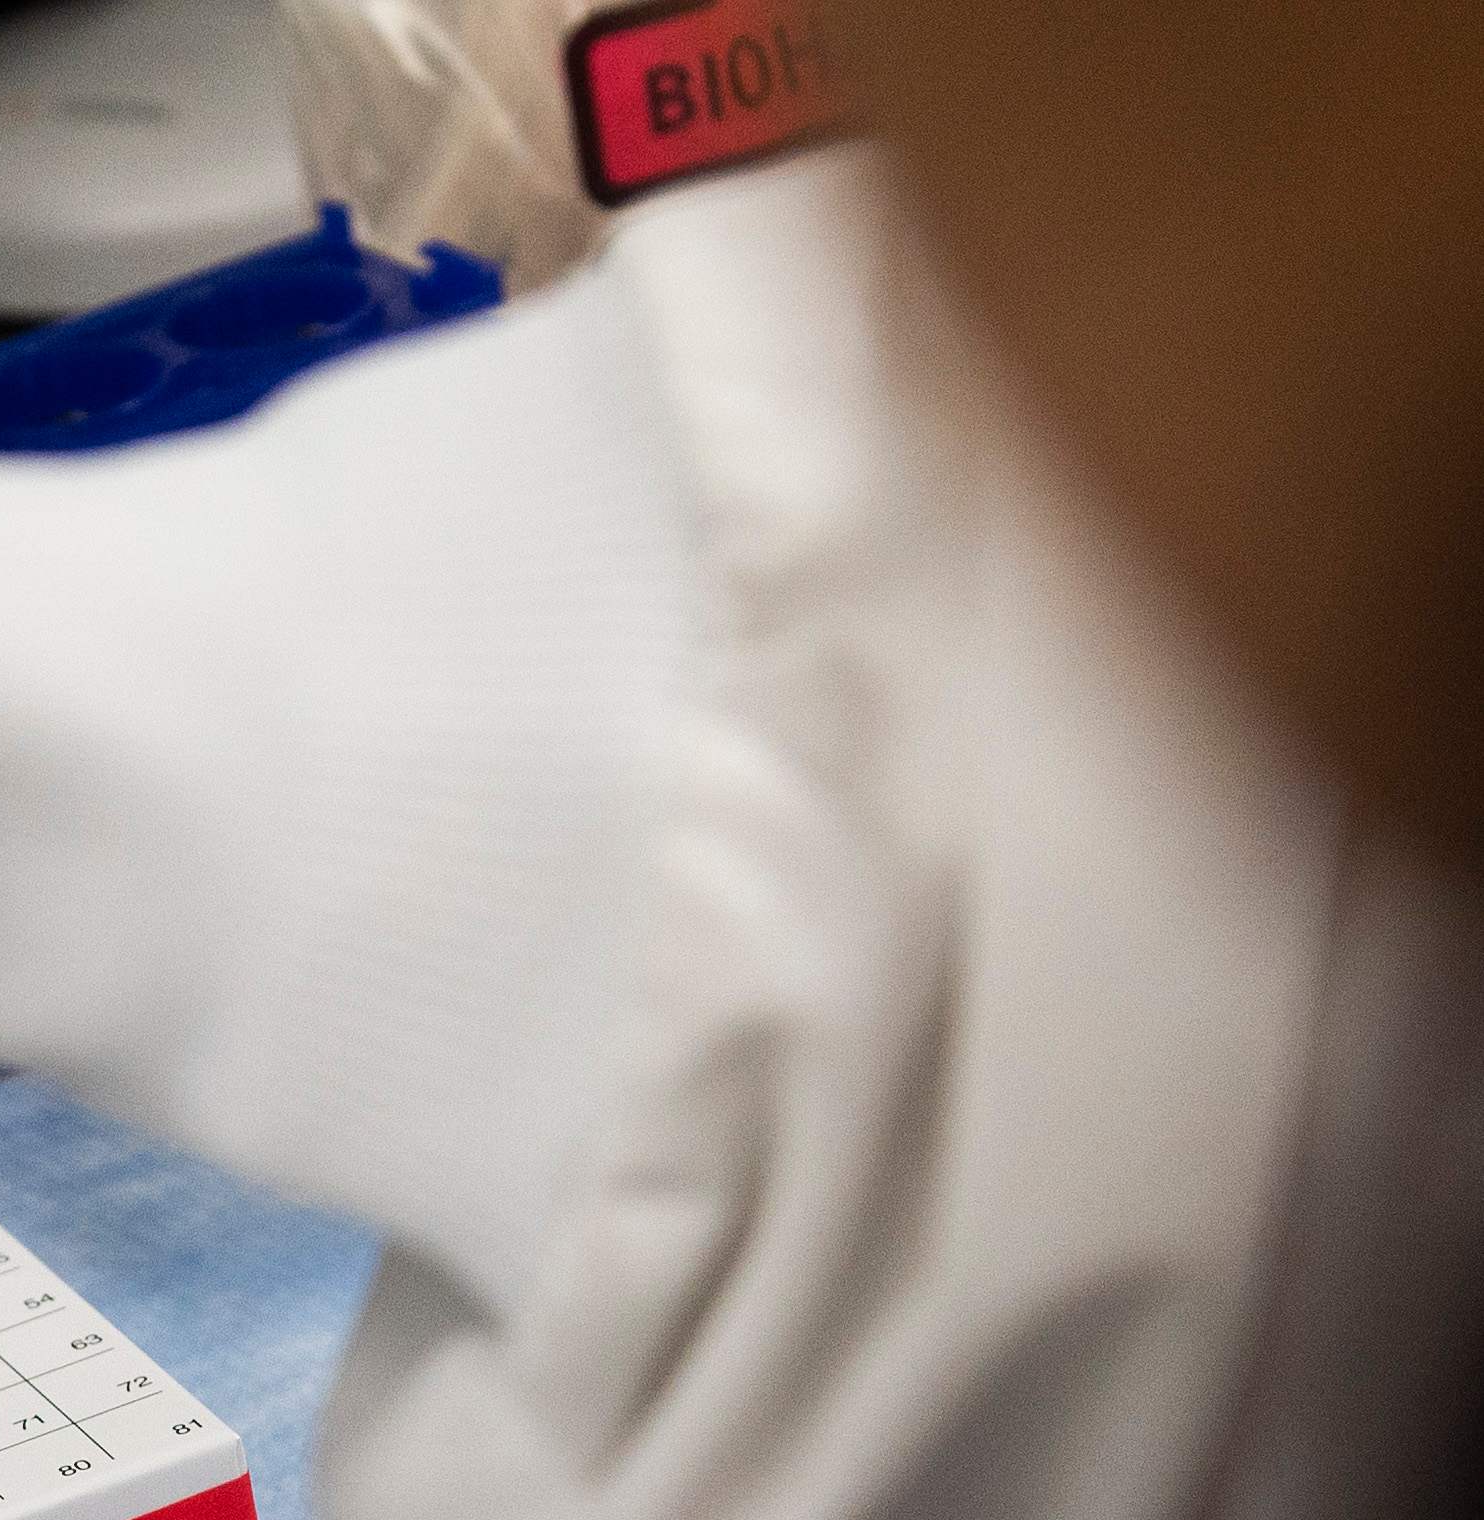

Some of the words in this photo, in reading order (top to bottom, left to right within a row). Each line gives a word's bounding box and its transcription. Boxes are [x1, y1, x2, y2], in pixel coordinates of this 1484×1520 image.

[22, 1292, 56, 1310] 54
[69, 1333, 104, 1351] 63
[12, 1413, 46, 1432] 71
[116, 1374, 153, 1394] 72
[57, 1458, 93, 1478] 80
[171, 1417, 204, 1436] 81
